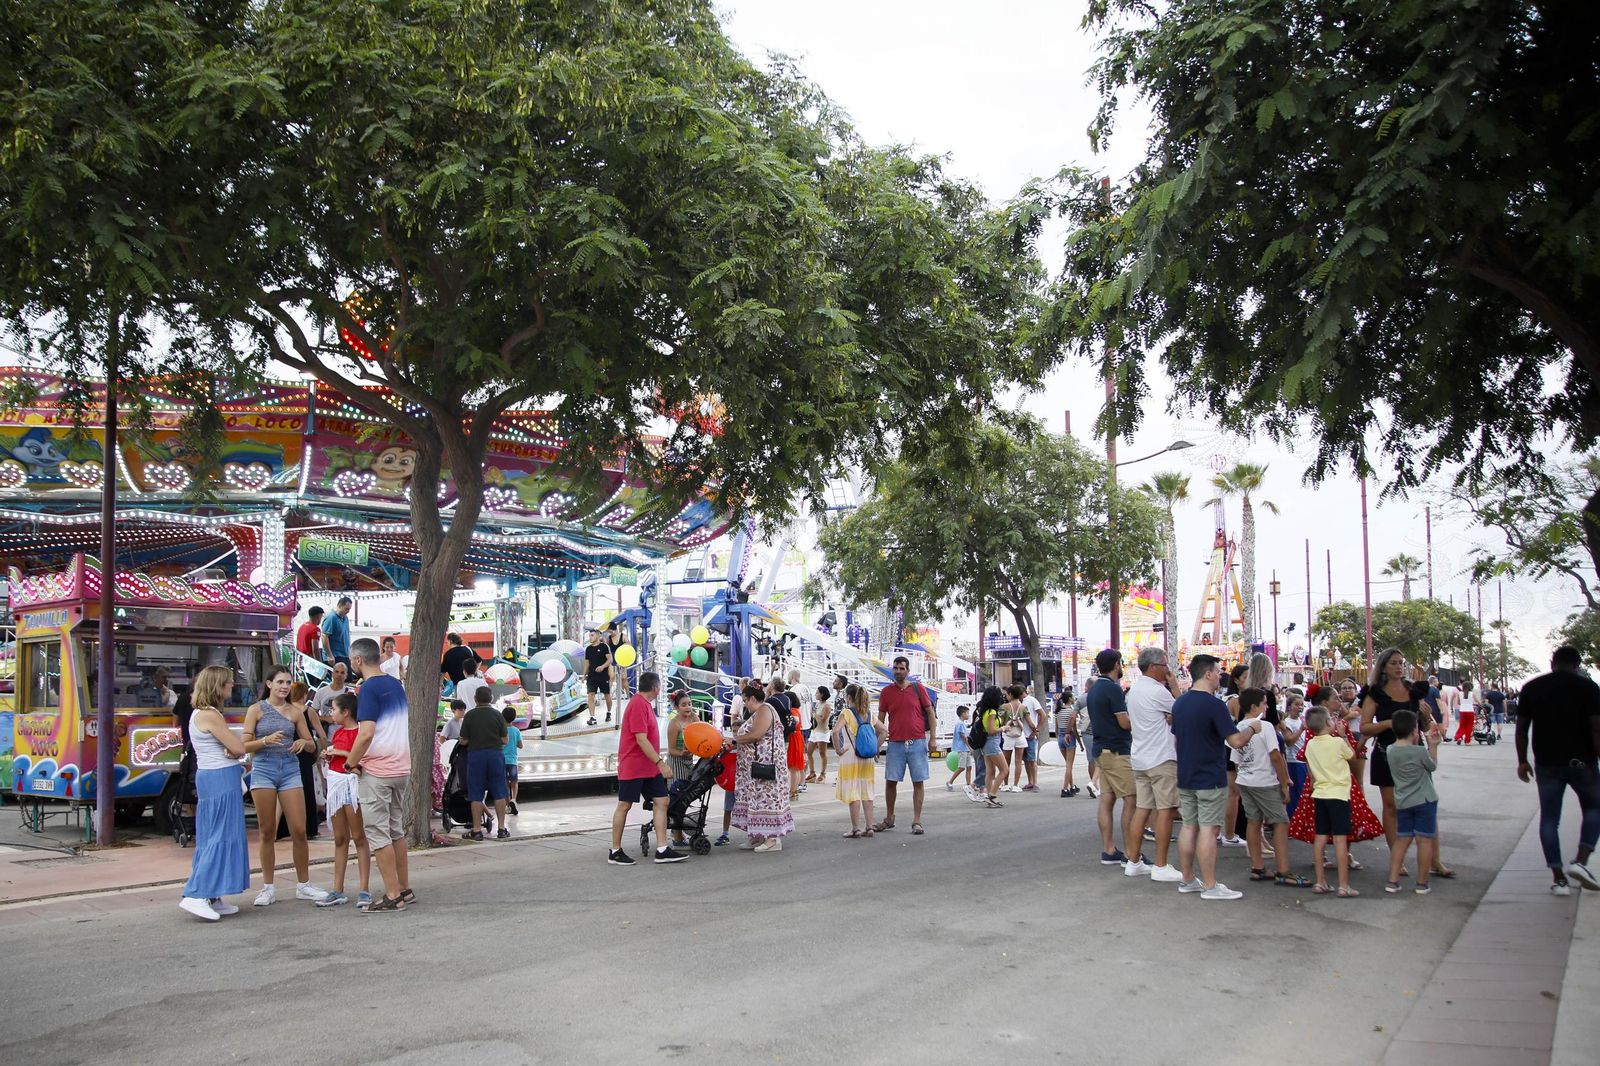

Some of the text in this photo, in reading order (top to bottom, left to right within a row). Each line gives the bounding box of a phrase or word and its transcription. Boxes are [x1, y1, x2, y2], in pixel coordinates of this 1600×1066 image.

[254, 416, 303, 430] LOCO
[305, 541, 353, 561] Salida
[31, 740, 59, 757] LOCO
